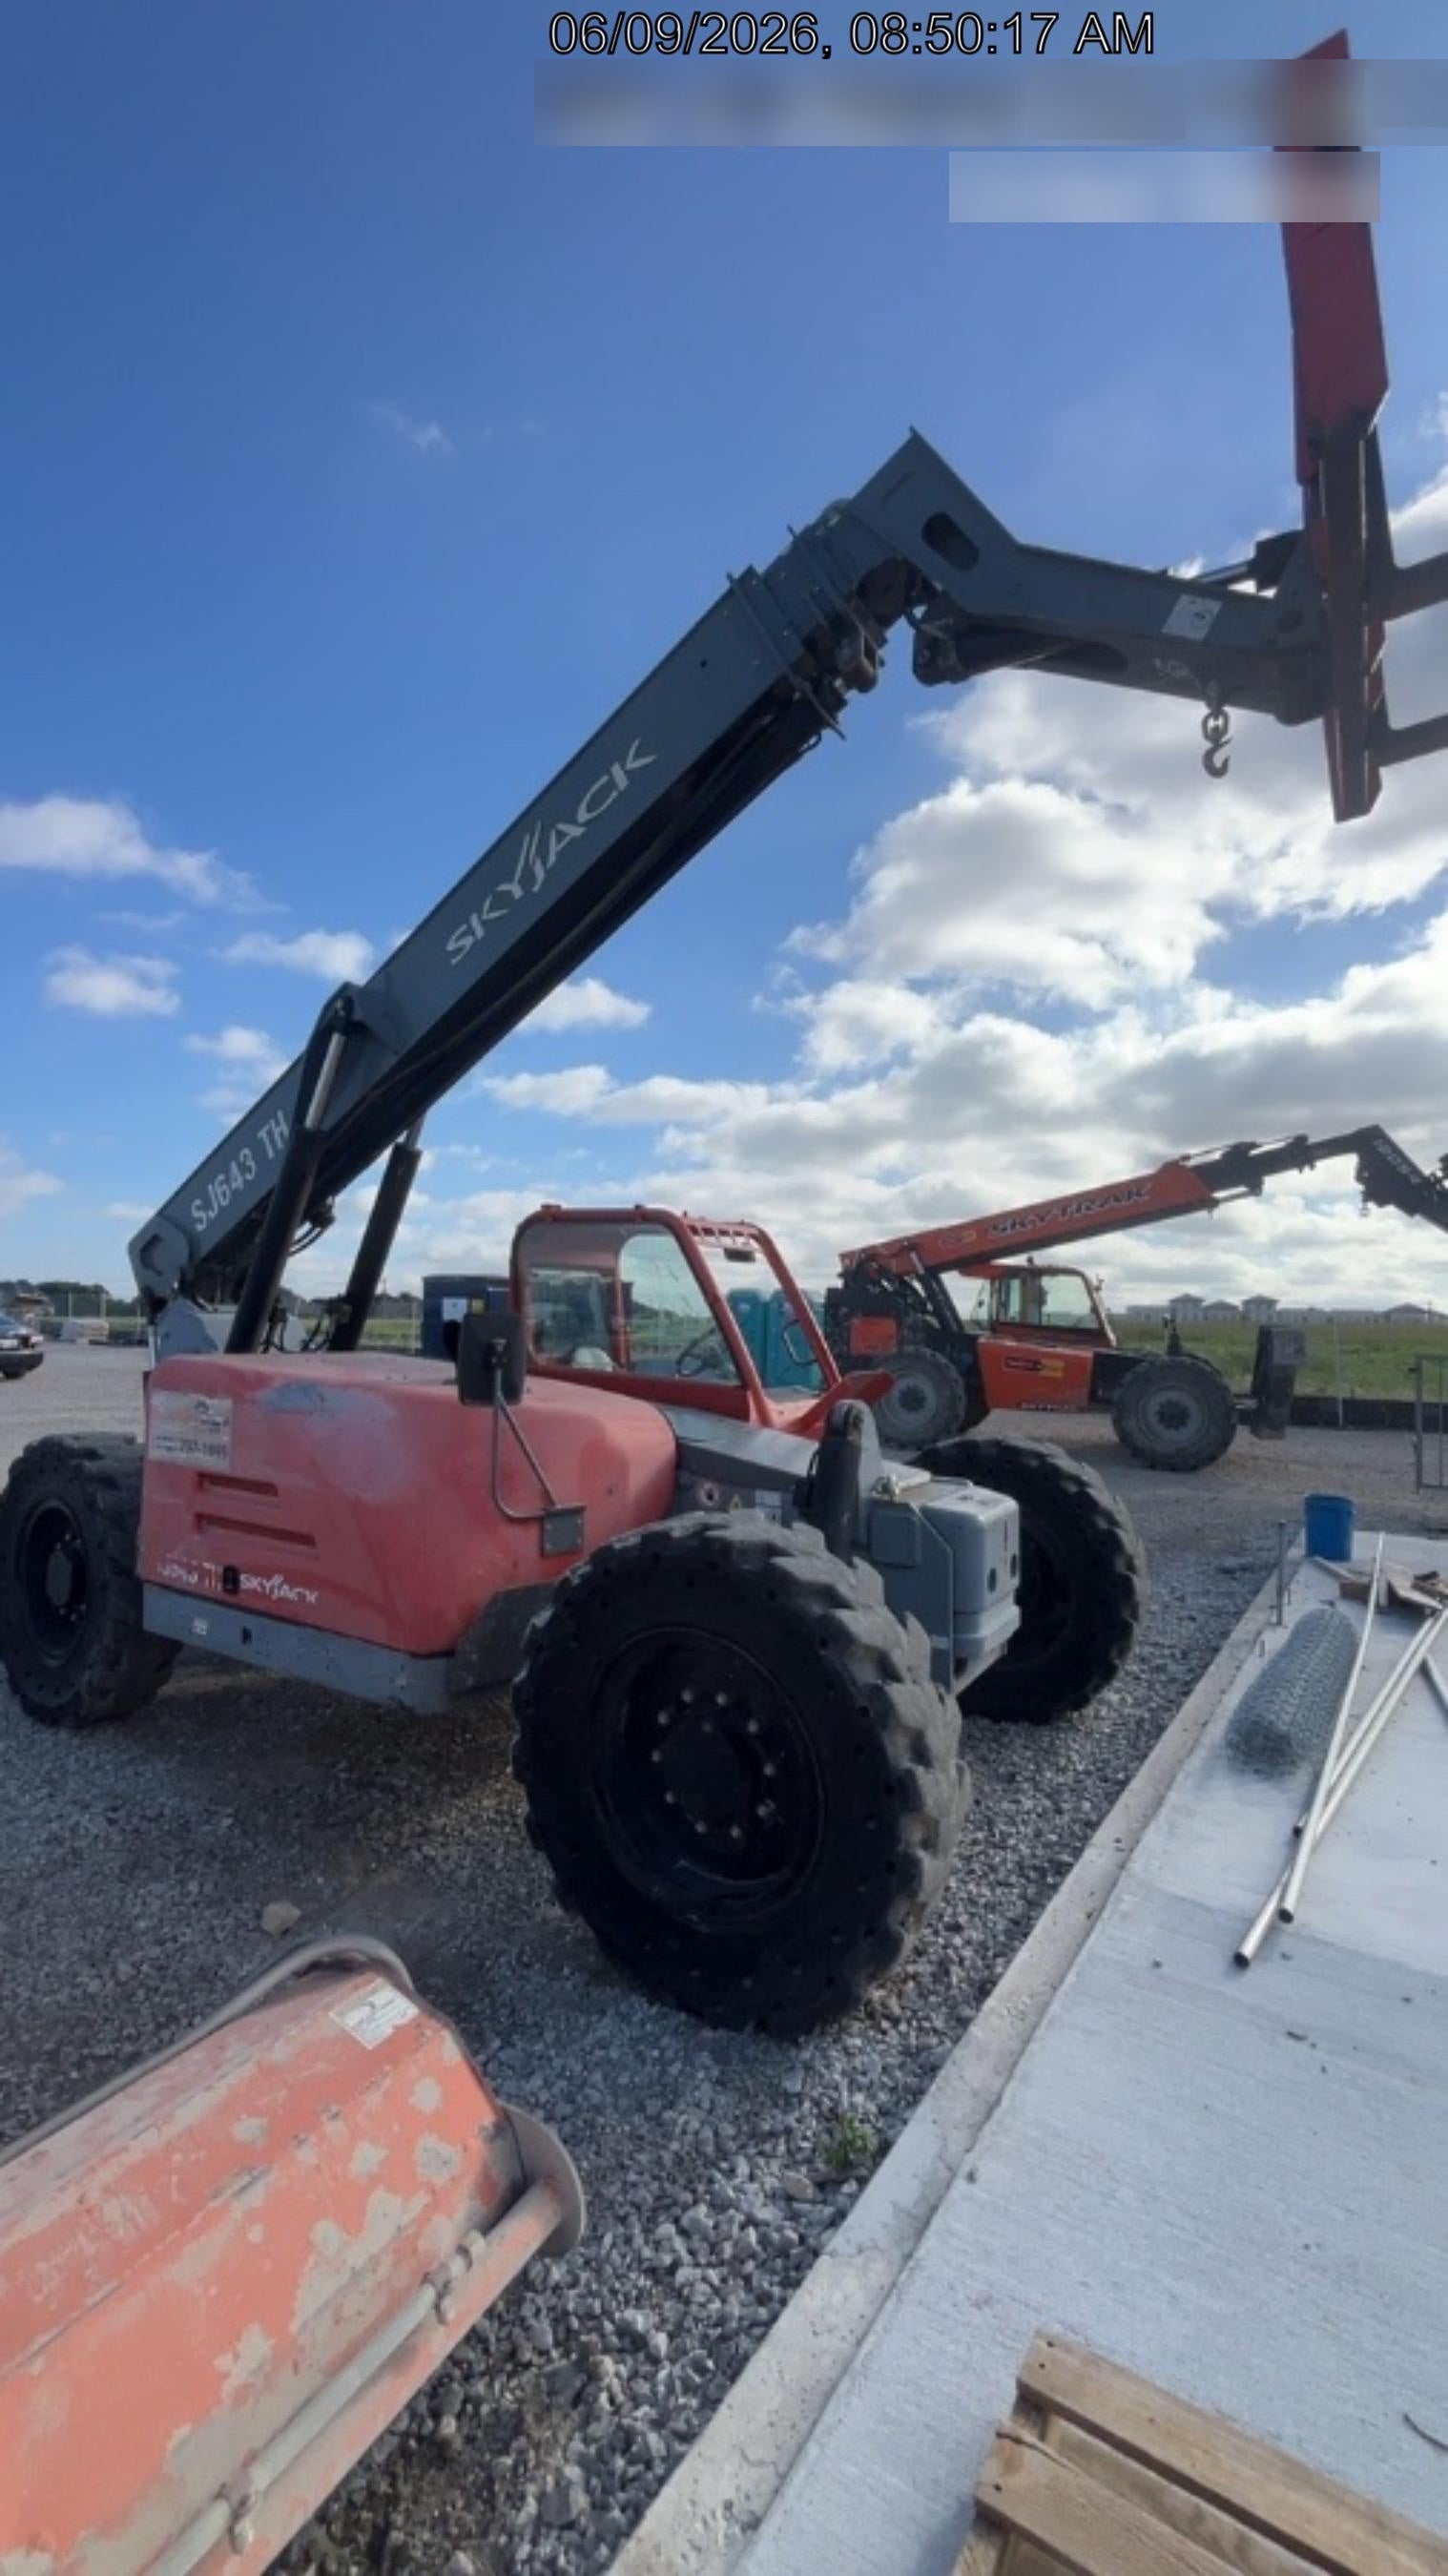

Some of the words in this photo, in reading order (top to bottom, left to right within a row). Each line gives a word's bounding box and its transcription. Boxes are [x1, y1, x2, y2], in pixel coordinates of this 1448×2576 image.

[445, 737, 657, 966] SKYJACK
[191, 1147, 257, 1232] SJ643
[257, 1110, 290, 1161] TH
[991, 1184, 1152, 1237] SKYTRAK
[239, 1574, 320, 1605] SKYJACK
